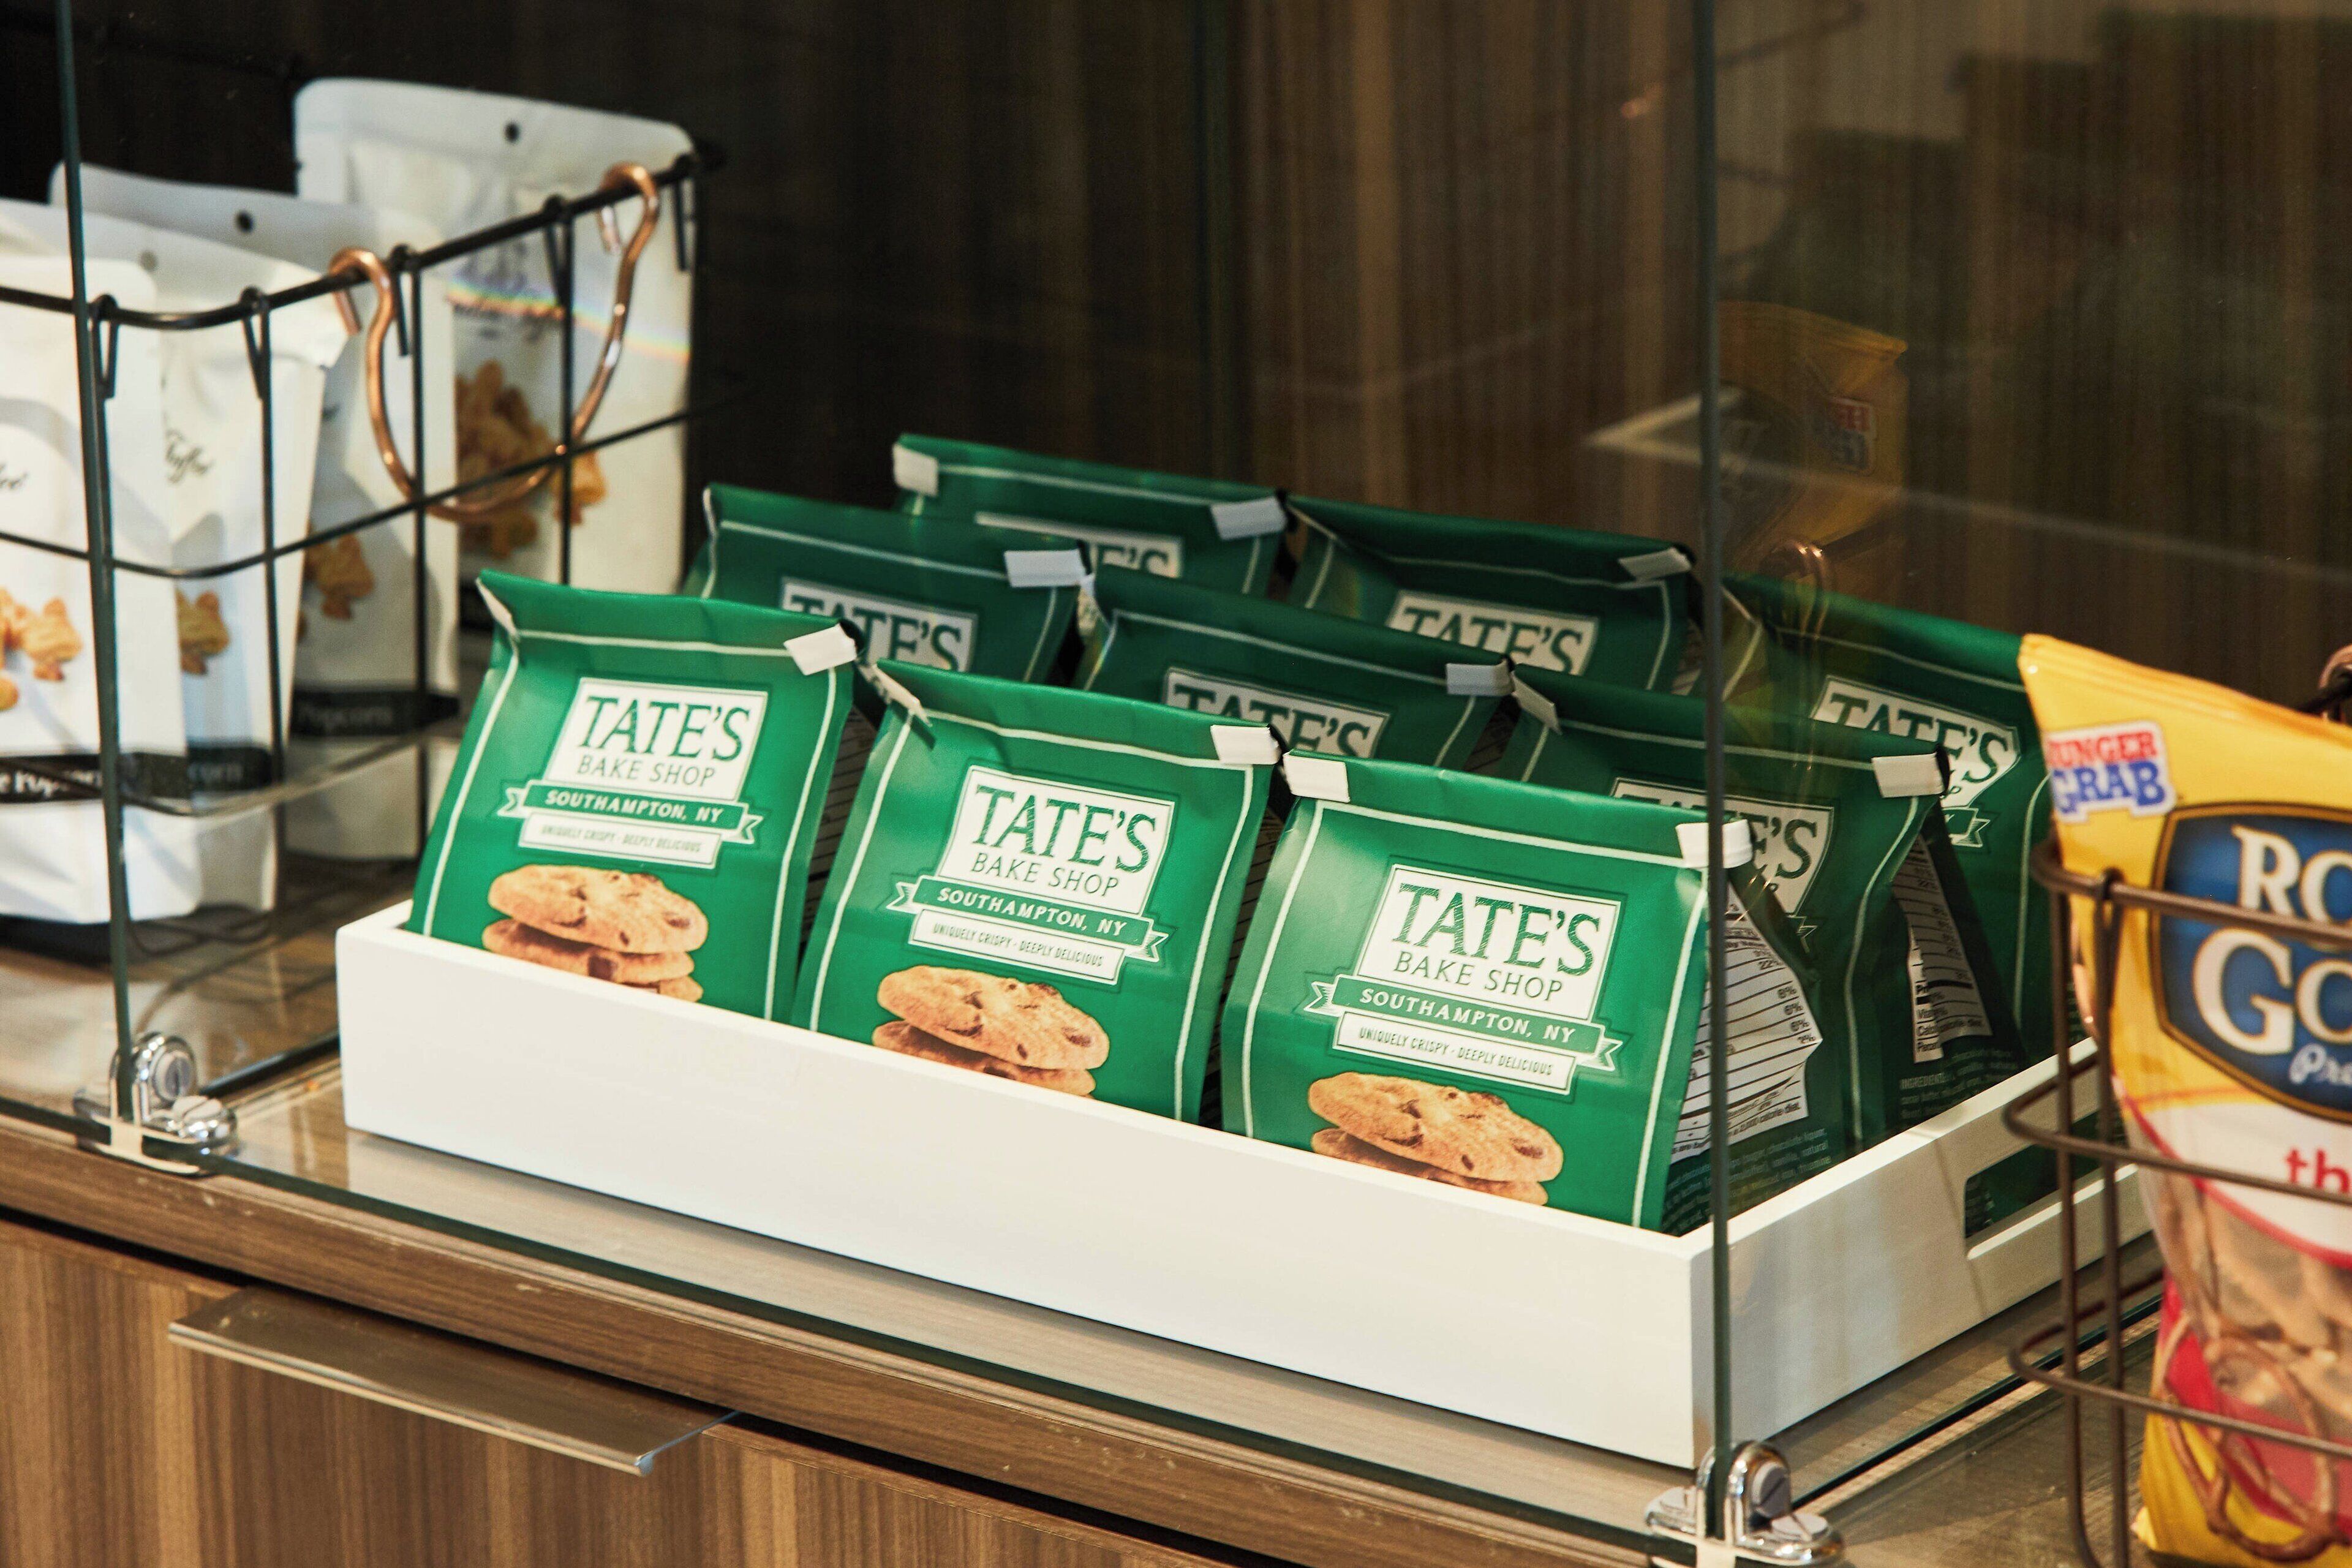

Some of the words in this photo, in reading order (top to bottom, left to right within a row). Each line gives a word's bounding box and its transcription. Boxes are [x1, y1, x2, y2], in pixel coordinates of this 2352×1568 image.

[578, 696, 750, 761] TATE'S
[577, 755, 641, 780] BAKE
[649, 763, 716, 789] SHOP
[545, 789, 687, 821] SOUTHAMPTON,
[695, 805, 725, 823] NY
[972, 785, 1156, 874] TATE'S
[541, 824, 581, 839] UNIQUELY
[583, 829, 615, 844] CRISPY
[622, 832, 654, 848] DEEPLY
[657, 837, 702, 853] DELICIOUS
[971, 853, 1041, 884] BAKE
[1049, 867, 1119, 898] SHOP
[938, 887, 1088, 932] SOUTHAMPTON,
[1096, 918, 1128, 937] NY
[1392, 883, 1600, 977] TATE'S
[932, 922, 978, 940] UNIQUELY
[979, 930, 1013, 948] CRISPY
[1019, 940, 1054, 957] DEEPLY
[1054, 946, 1104, 967] DELICIOUS
[1393, 951, 1475, 986] BAKE
[1484, 968, 1563, 1002] SHOP
[1359, 987, 1533, 1038] SOUTHAMPTON,
[1543, 1024, 1575, 1044] NY
[1359, 1027, 1409, 1048] UNIQUELY
[1411, 1036, 1450, 1057] CRISPY
[1457, 1046, 1496, 1066] DEEPLY
[1497, 1053, 1554, 1076] DELICIOUS
[2285, 1147, 2350, 1194] th
